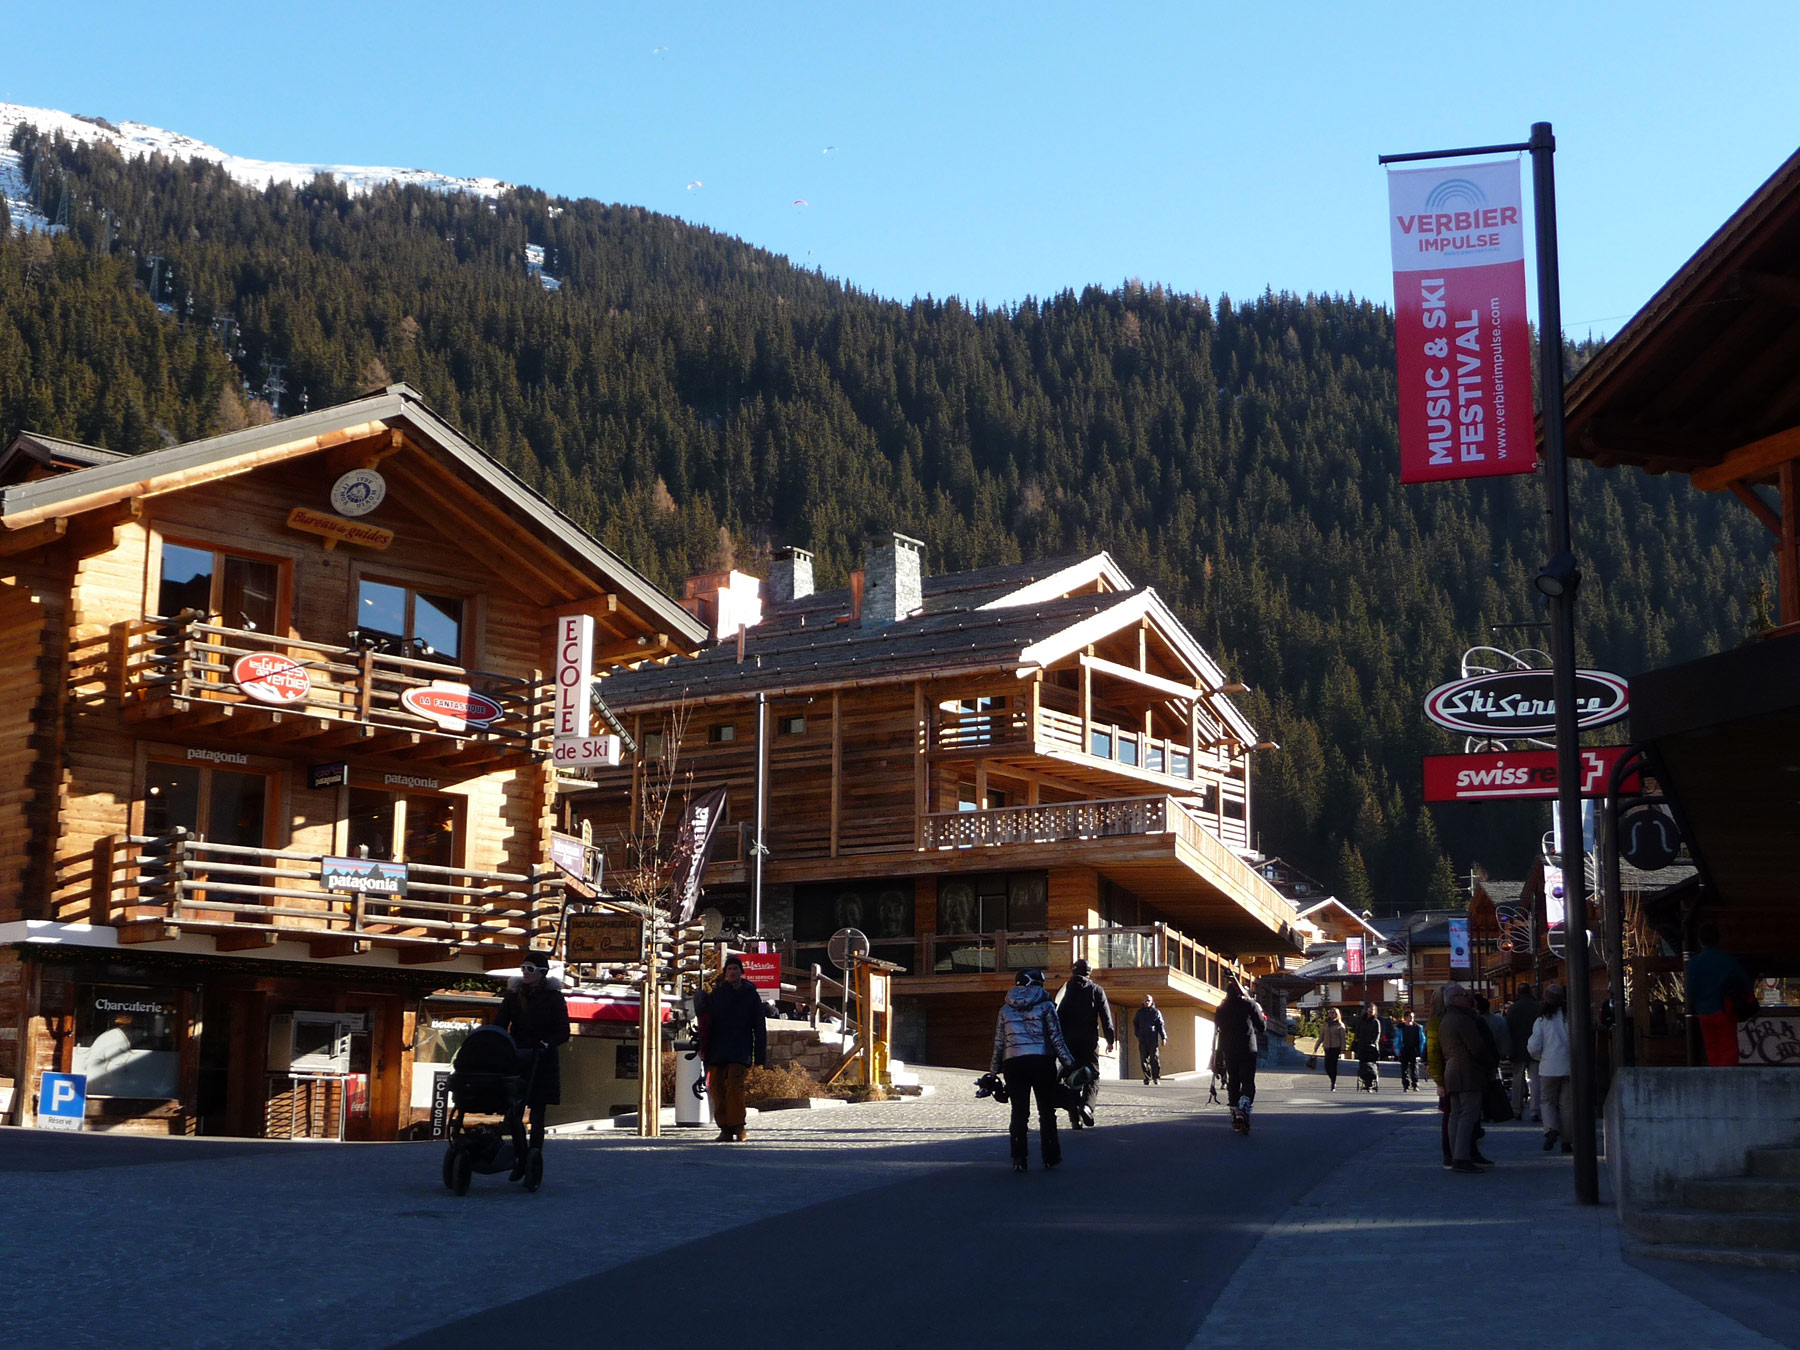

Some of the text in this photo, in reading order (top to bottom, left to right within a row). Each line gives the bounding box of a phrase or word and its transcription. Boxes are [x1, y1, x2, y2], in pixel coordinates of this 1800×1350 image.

[1396, 206, 1518, 236] VERBIER
[1419, 232, 1500, 252] IMPULSE
[1421, 277, 1453, 466] MUSIC & SKI
[1490, 296, 1508, 460] www.verbierimpulse.com
[1455, 309, 1485, 463] FESTIVAL
[293, 511, 337, 531] Bureau
[345, 527, 390, 544] guides
[261, 657, 304, 677] Guides
[559, 620, 580, 733] ECOLE
[434, 699, 486, 714] FANTASTIQUE
[1443, 689, 1497, 713] Ski
[187, 748, 248, 764] patagonia
[555, 740, 608, 760] de Ski
[384, 773, 439, 788] patagonia
[328, 874, 399, 892] patagonia
[95, 998, 162, 1013] Charcuterie
[51, 1079, 76, 1112] P
[432, 1082, 446, 1137] CLOSED
